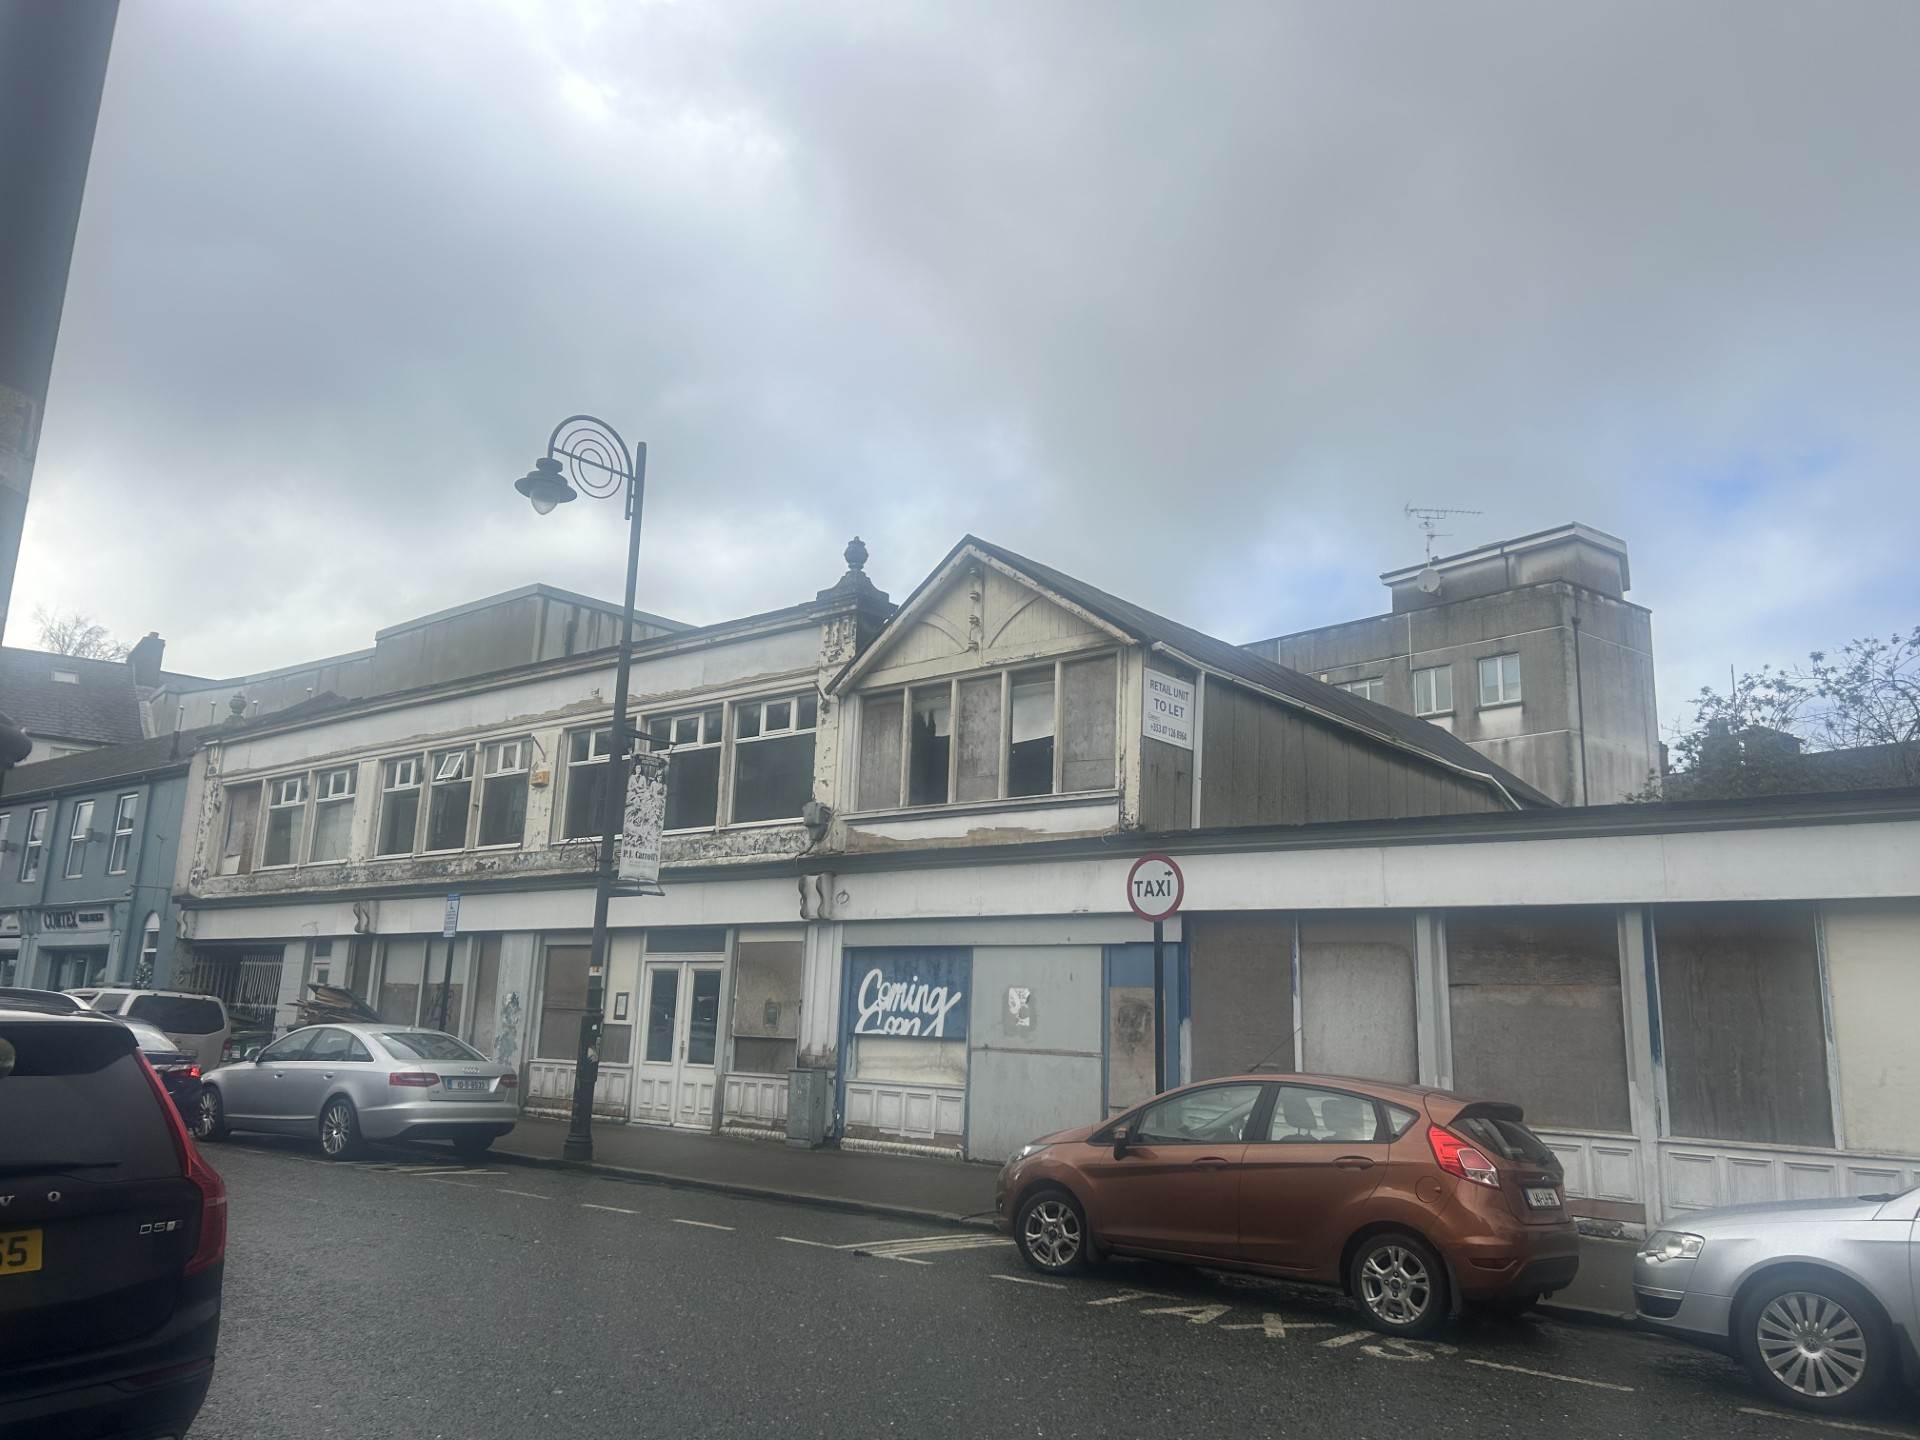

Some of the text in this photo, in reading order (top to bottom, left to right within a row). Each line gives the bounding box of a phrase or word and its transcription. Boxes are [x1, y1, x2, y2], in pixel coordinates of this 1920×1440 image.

[1150, 679, 1189, 702] RETAIL UNIT
[1154, 698, 1167, 712] TO
[1168, 703, 1185, 718] LET
[1134, 880, 1171, 897] TAXI
[858, 968, 962, 1037] Coming
